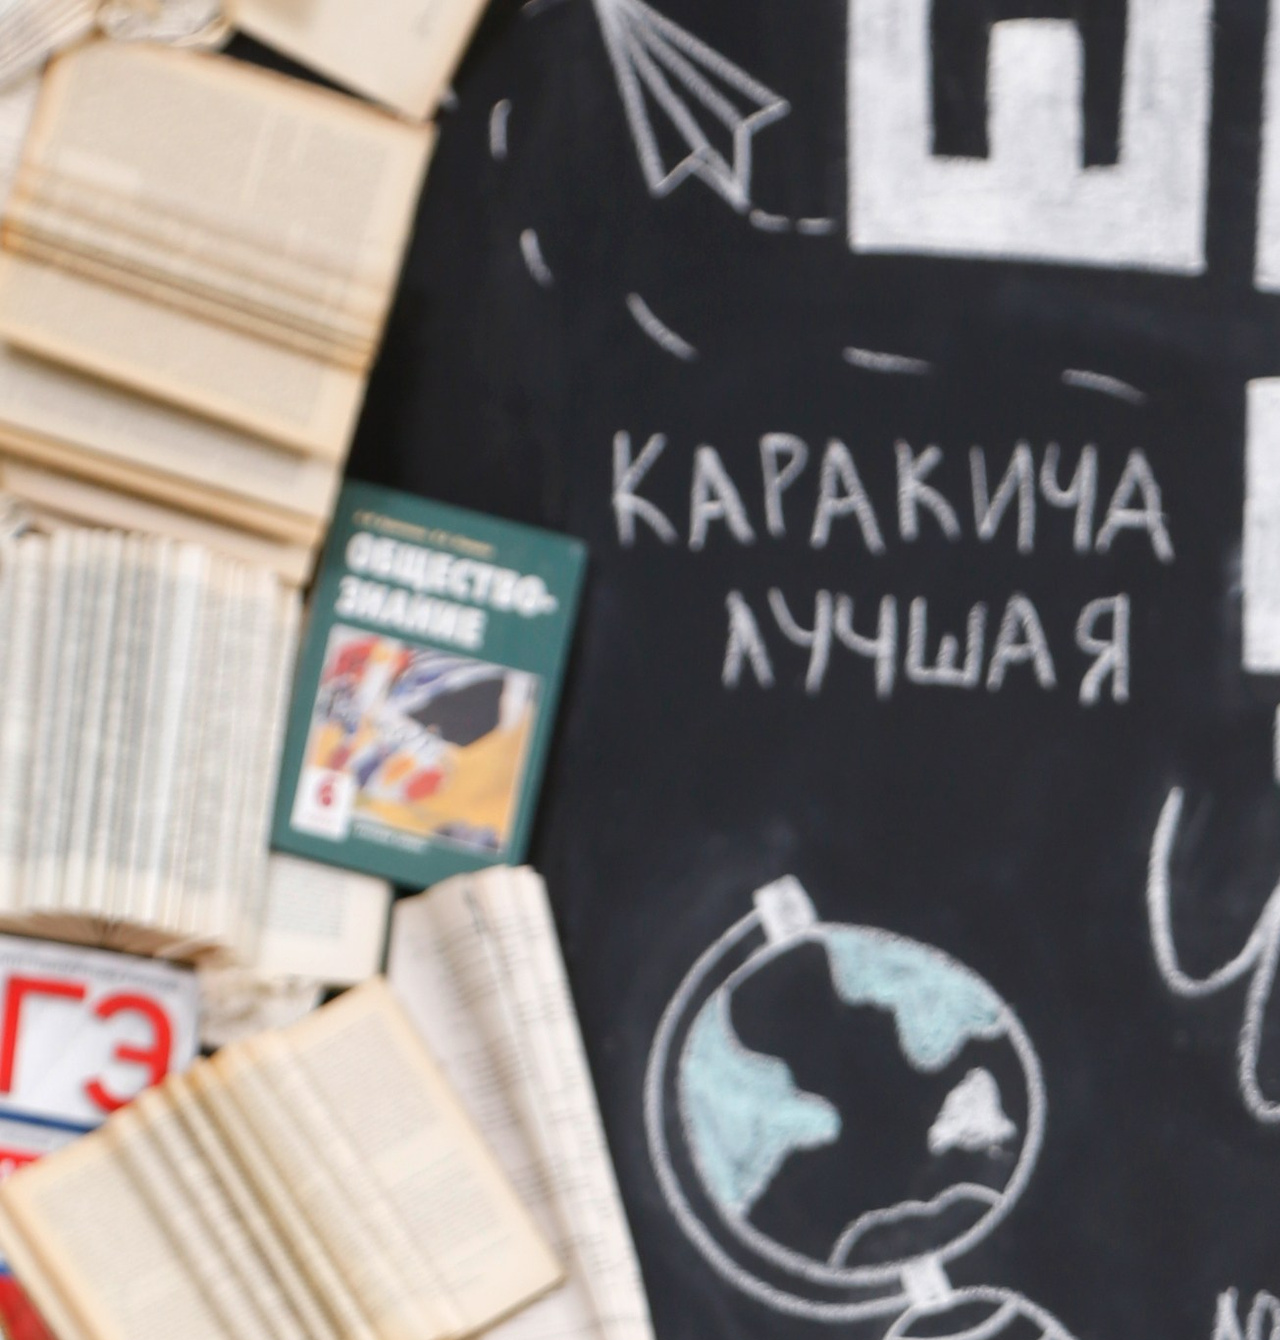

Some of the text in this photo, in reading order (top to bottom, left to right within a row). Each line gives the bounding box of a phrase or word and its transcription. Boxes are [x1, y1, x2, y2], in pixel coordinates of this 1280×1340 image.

[611, 430, 1175, 562] КАРАКИЧА
[333, 574, 488, 651] ЗНАНИЕ
[721, 587, 1130, 705] ЛУЧШАЯ
